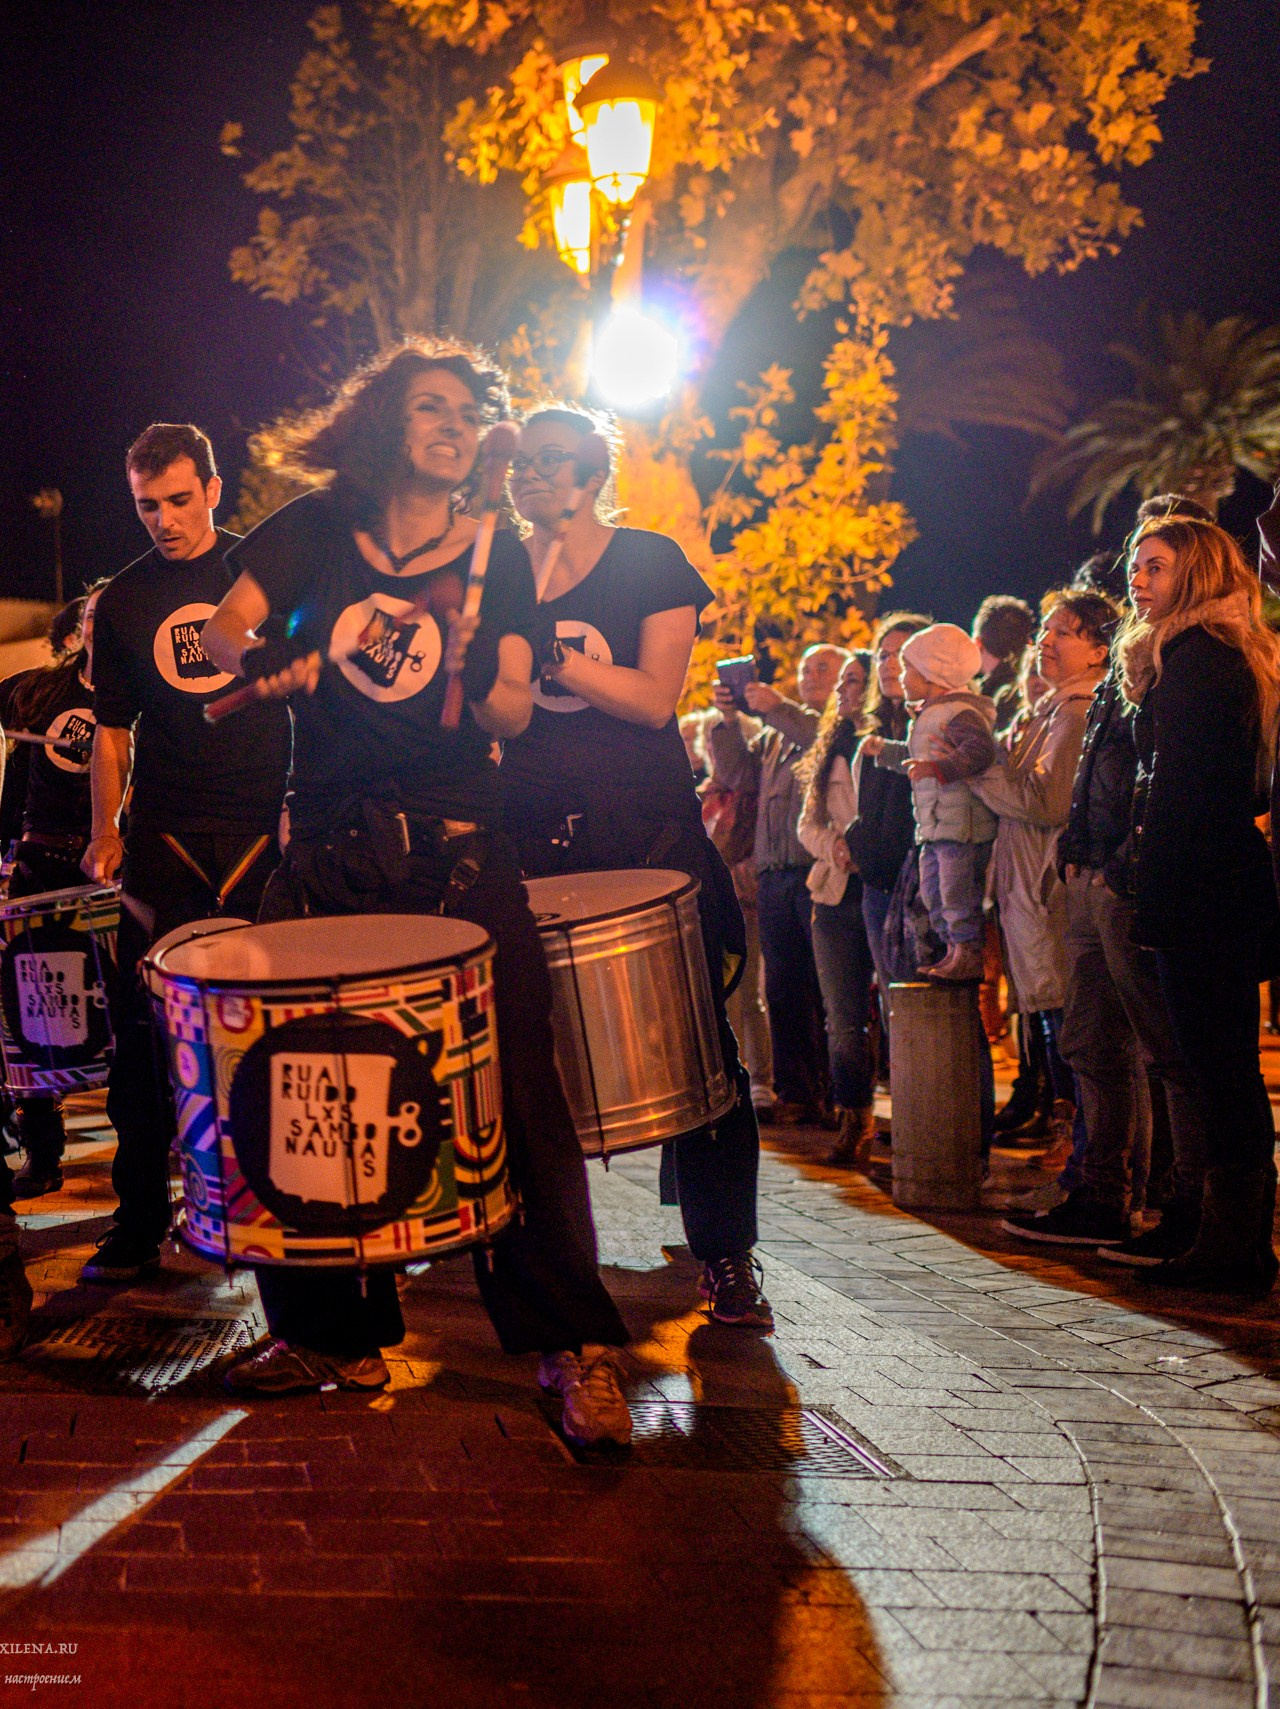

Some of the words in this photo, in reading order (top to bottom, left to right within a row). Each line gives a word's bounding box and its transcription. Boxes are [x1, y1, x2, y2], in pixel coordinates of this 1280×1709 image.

[176, 632, 200, 643] RUID
[282, 1063, 332, 1083] RUA
[282, 1082, 357, 1102] RUIDO
[305, 1102, 352, 1122] LXS
[291, 1119, 377, 1140] SAMBO
